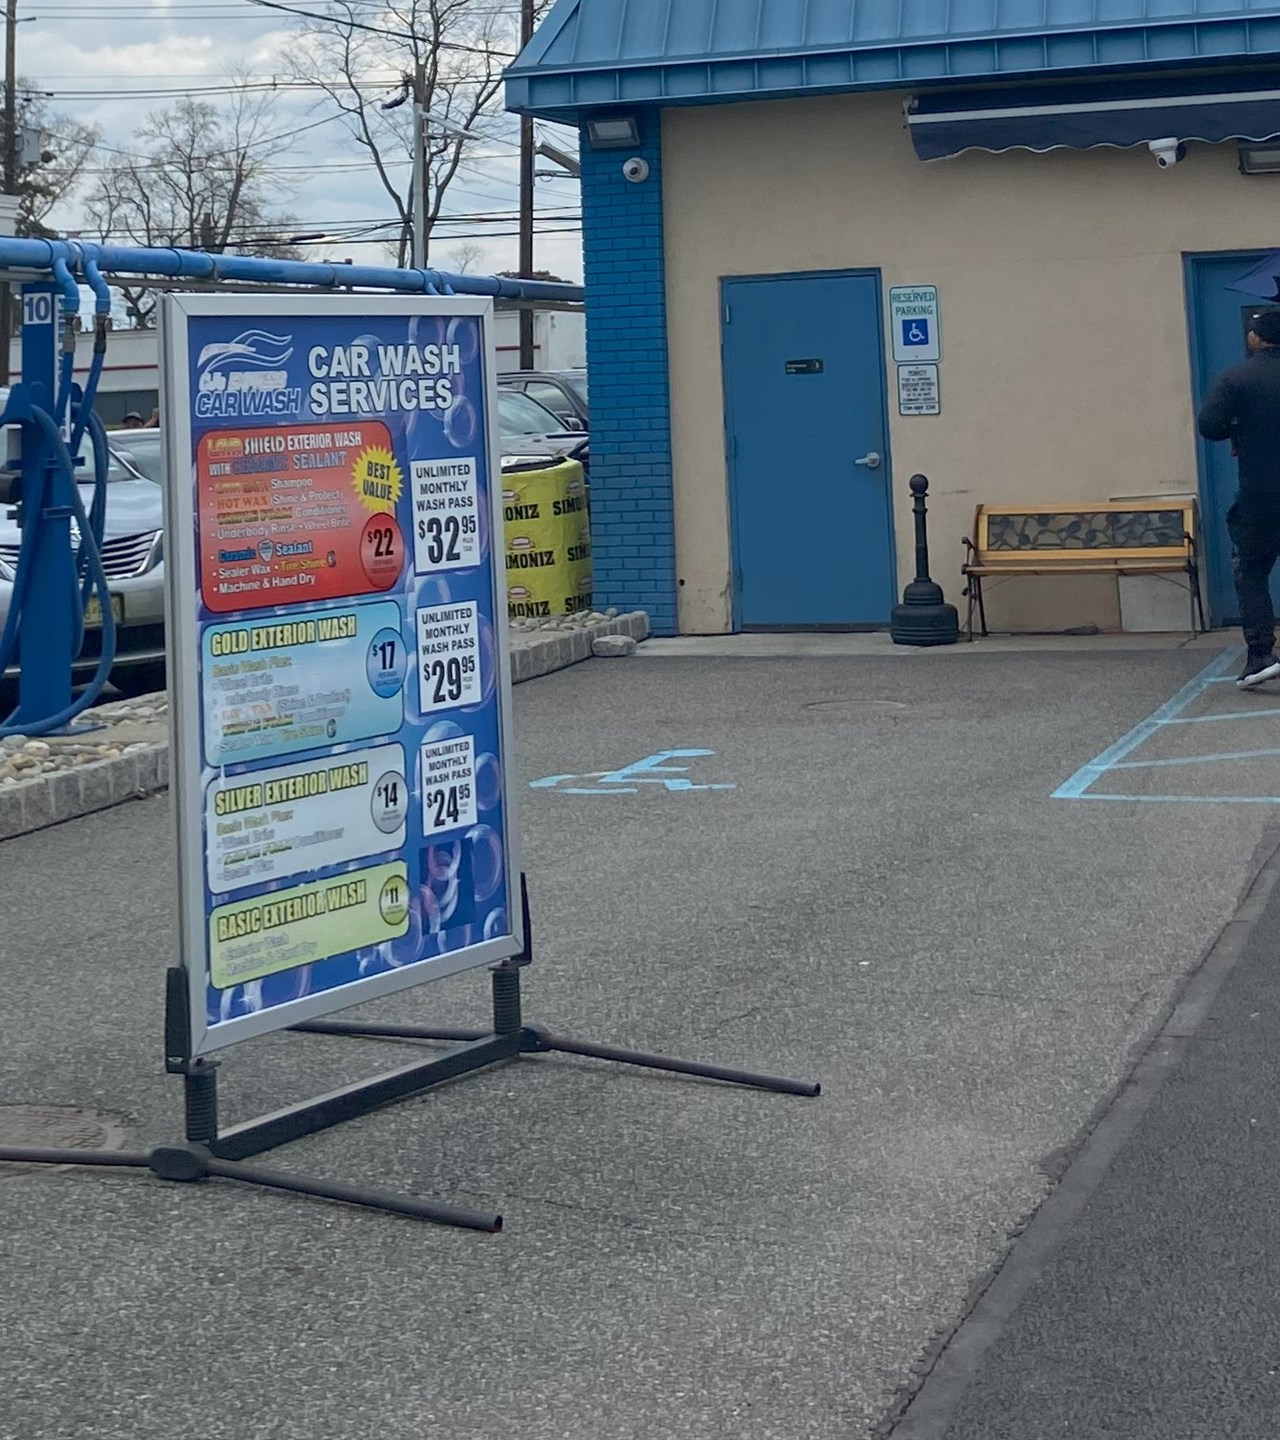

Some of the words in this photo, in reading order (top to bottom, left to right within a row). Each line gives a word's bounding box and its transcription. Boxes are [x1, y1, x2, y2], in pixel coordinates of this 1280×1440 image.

[892, 291, 935, 303] RESERVED
[24, 296, 50, 322] 10
[895, 305, 933, 316] PARKING
[308, 345, 370, 378] CAR
[377, 343, 460, 377] WASH
[195, 391, 239, 417] CAR
[241, 388, 301, 416] WASH
[310, 378, 453, 414] SERVICES
[245, 436, 285, 455] SHIELD
[287, 433, 332, 451] EXTERIOR
[334, 431, 362, 447] WASH
[293, 451, 347, 470] SEALANT
[367, 461, 390, 481] BEST
[416, 464, 470, 478] UNLIMITED
[363, 479, 392, 501] VALUE
[420, 480, 468, 495] MONTHLY
[416, 499, 445, 512] WASH
[448, 496, 473, 509] PASS
[275, 540, 313, 555] Sealant
[367, 527, 394, 557] $22
[251, 563, 271, 575] Wax
[219, 580, 259, 594] Machine
[262, 578, 270, 588] &
[272, 575, 297, 587] Hand
[299, 572, 316, 586] Dry
[422, 608, 472, 624] UNLIMITED
[211, 629, 248, 657] GOLD
[250, 620, 316, 652] EXTERIOR
[317, 614, 356, 641] WASH
[425, 623, 470, 639] MONTHLY
[372, 640, 395, 670] $17
[422, 641, 449, 655] WASH
[452, 637, 475, 651] PASS
[426, 741, 470, 759] UNLIMITED
[429, 755, 468, 771] MONTHLY
[426, 773, 449, 786] WASH
[452, 768, 472, 780] PASS
[215, 783, 262, 816] SILVER
[265, 770, 327, 806] EXTERIOR
[328, 761, 368, 792] WASH
[378, 782, 398, 808] $14
[218, 907, 260, 942] BASIC
[263, 891, 326, 930] EXTERIOR
[326, 879, 366, 912] WASH
